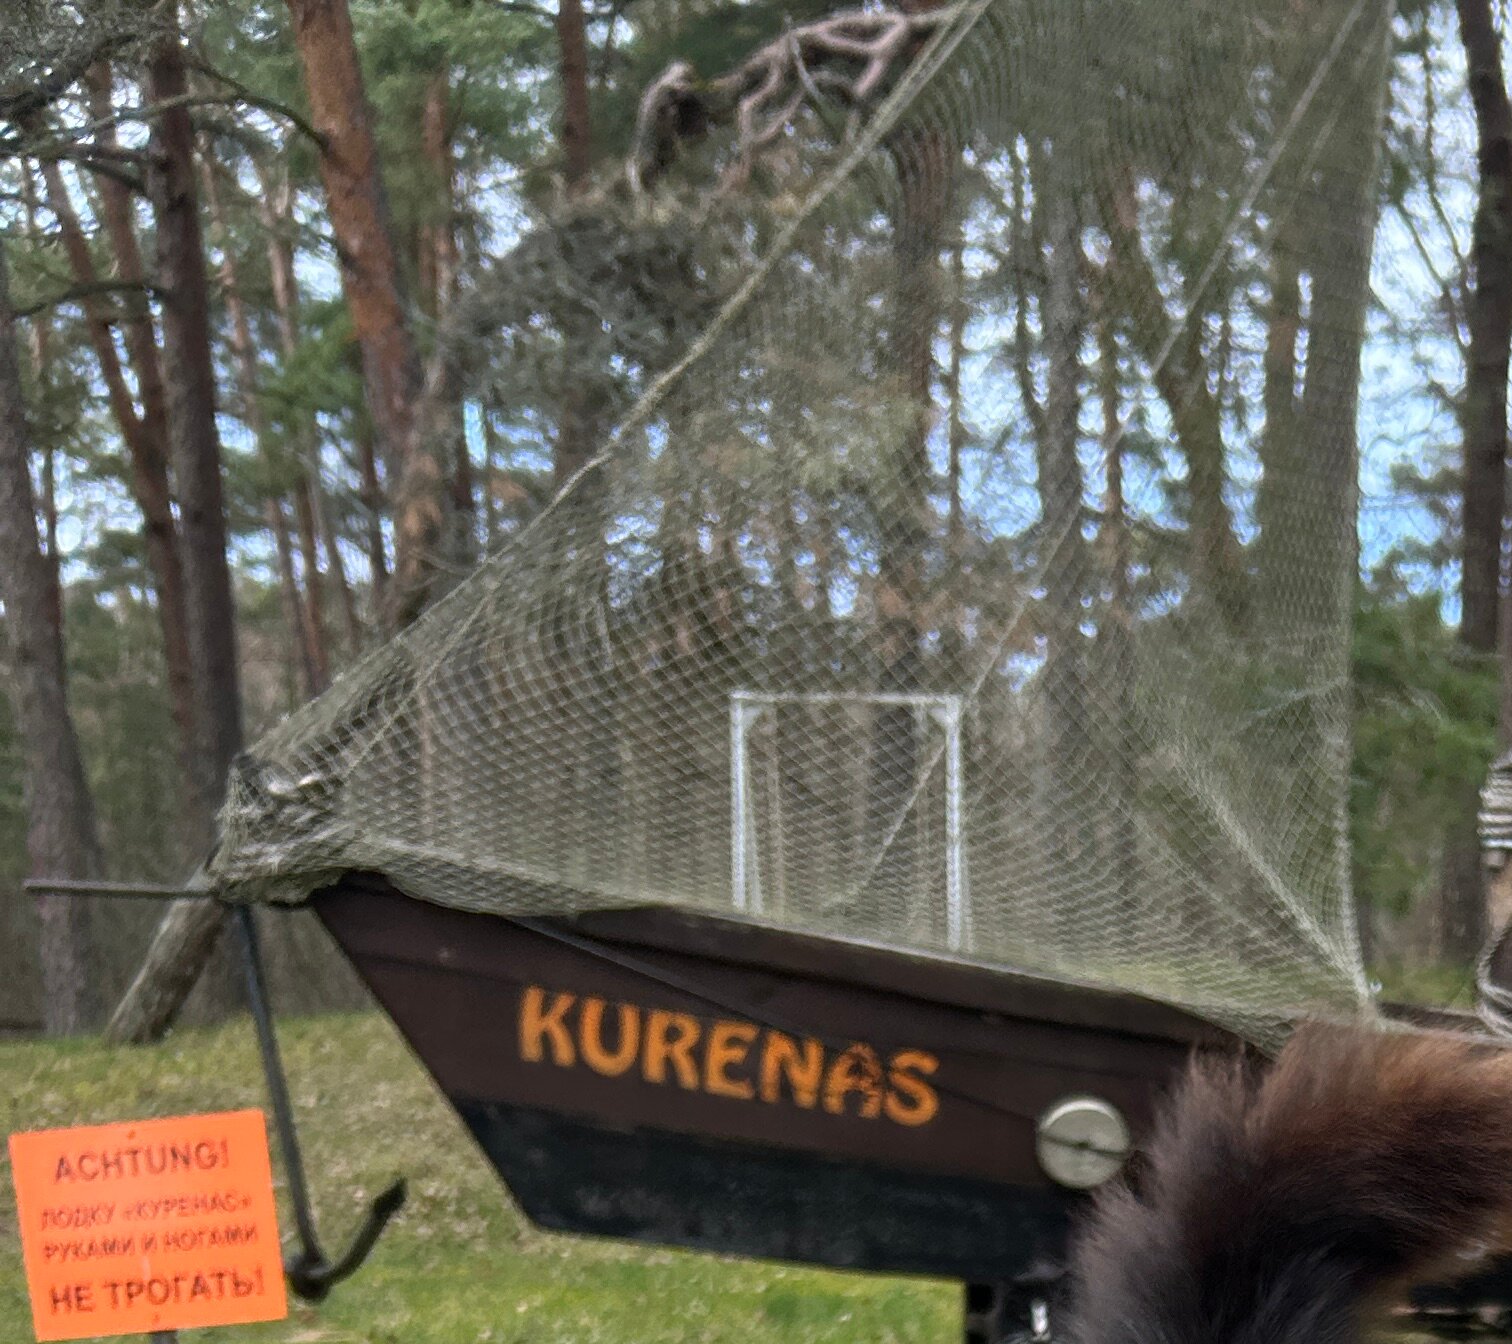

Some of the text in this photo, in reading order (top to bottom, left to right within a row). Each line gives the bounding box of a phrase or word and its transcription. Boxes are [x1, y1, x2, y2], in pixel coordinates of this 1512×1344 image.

[518, 984, 940, 1128] KURENAS
[54, 1138, 230, 1184] ACHTUNG!
[43, 1221, 258, 1264] РУКАМИ И НОГАМИ
[48, 1263, 266, 1316] НЕ ТРОГАТЬ!
